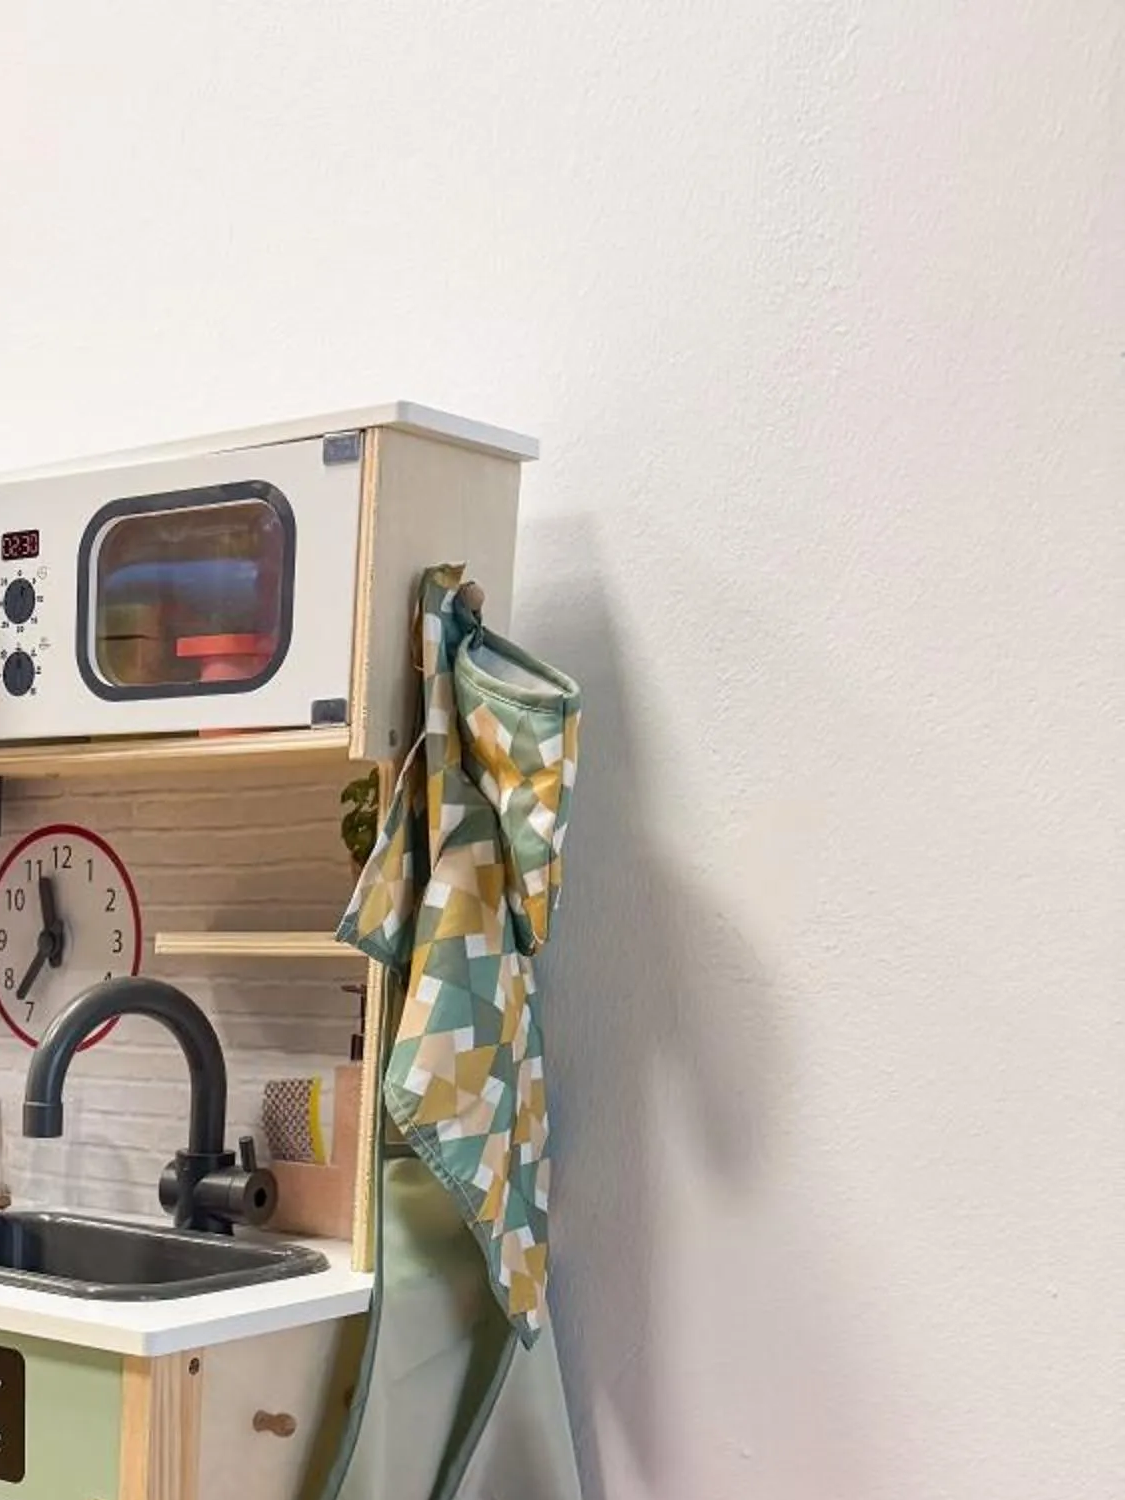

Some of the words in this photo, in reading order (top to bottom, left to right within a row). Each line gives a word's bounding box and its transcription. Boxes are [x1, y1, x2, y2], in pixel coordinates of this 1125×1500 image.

[52, 845, 72, 869] 12
[26, 859, 43, 881] 11
[85, 859, 94, 882] 1
[6, 888, 25, 911] 10
[105, 888, 116, 912] 2
[112, 930, 123, 953] 3
[4, 967, 15, 990] 8
[25, 1001, 35, 1022] 7
